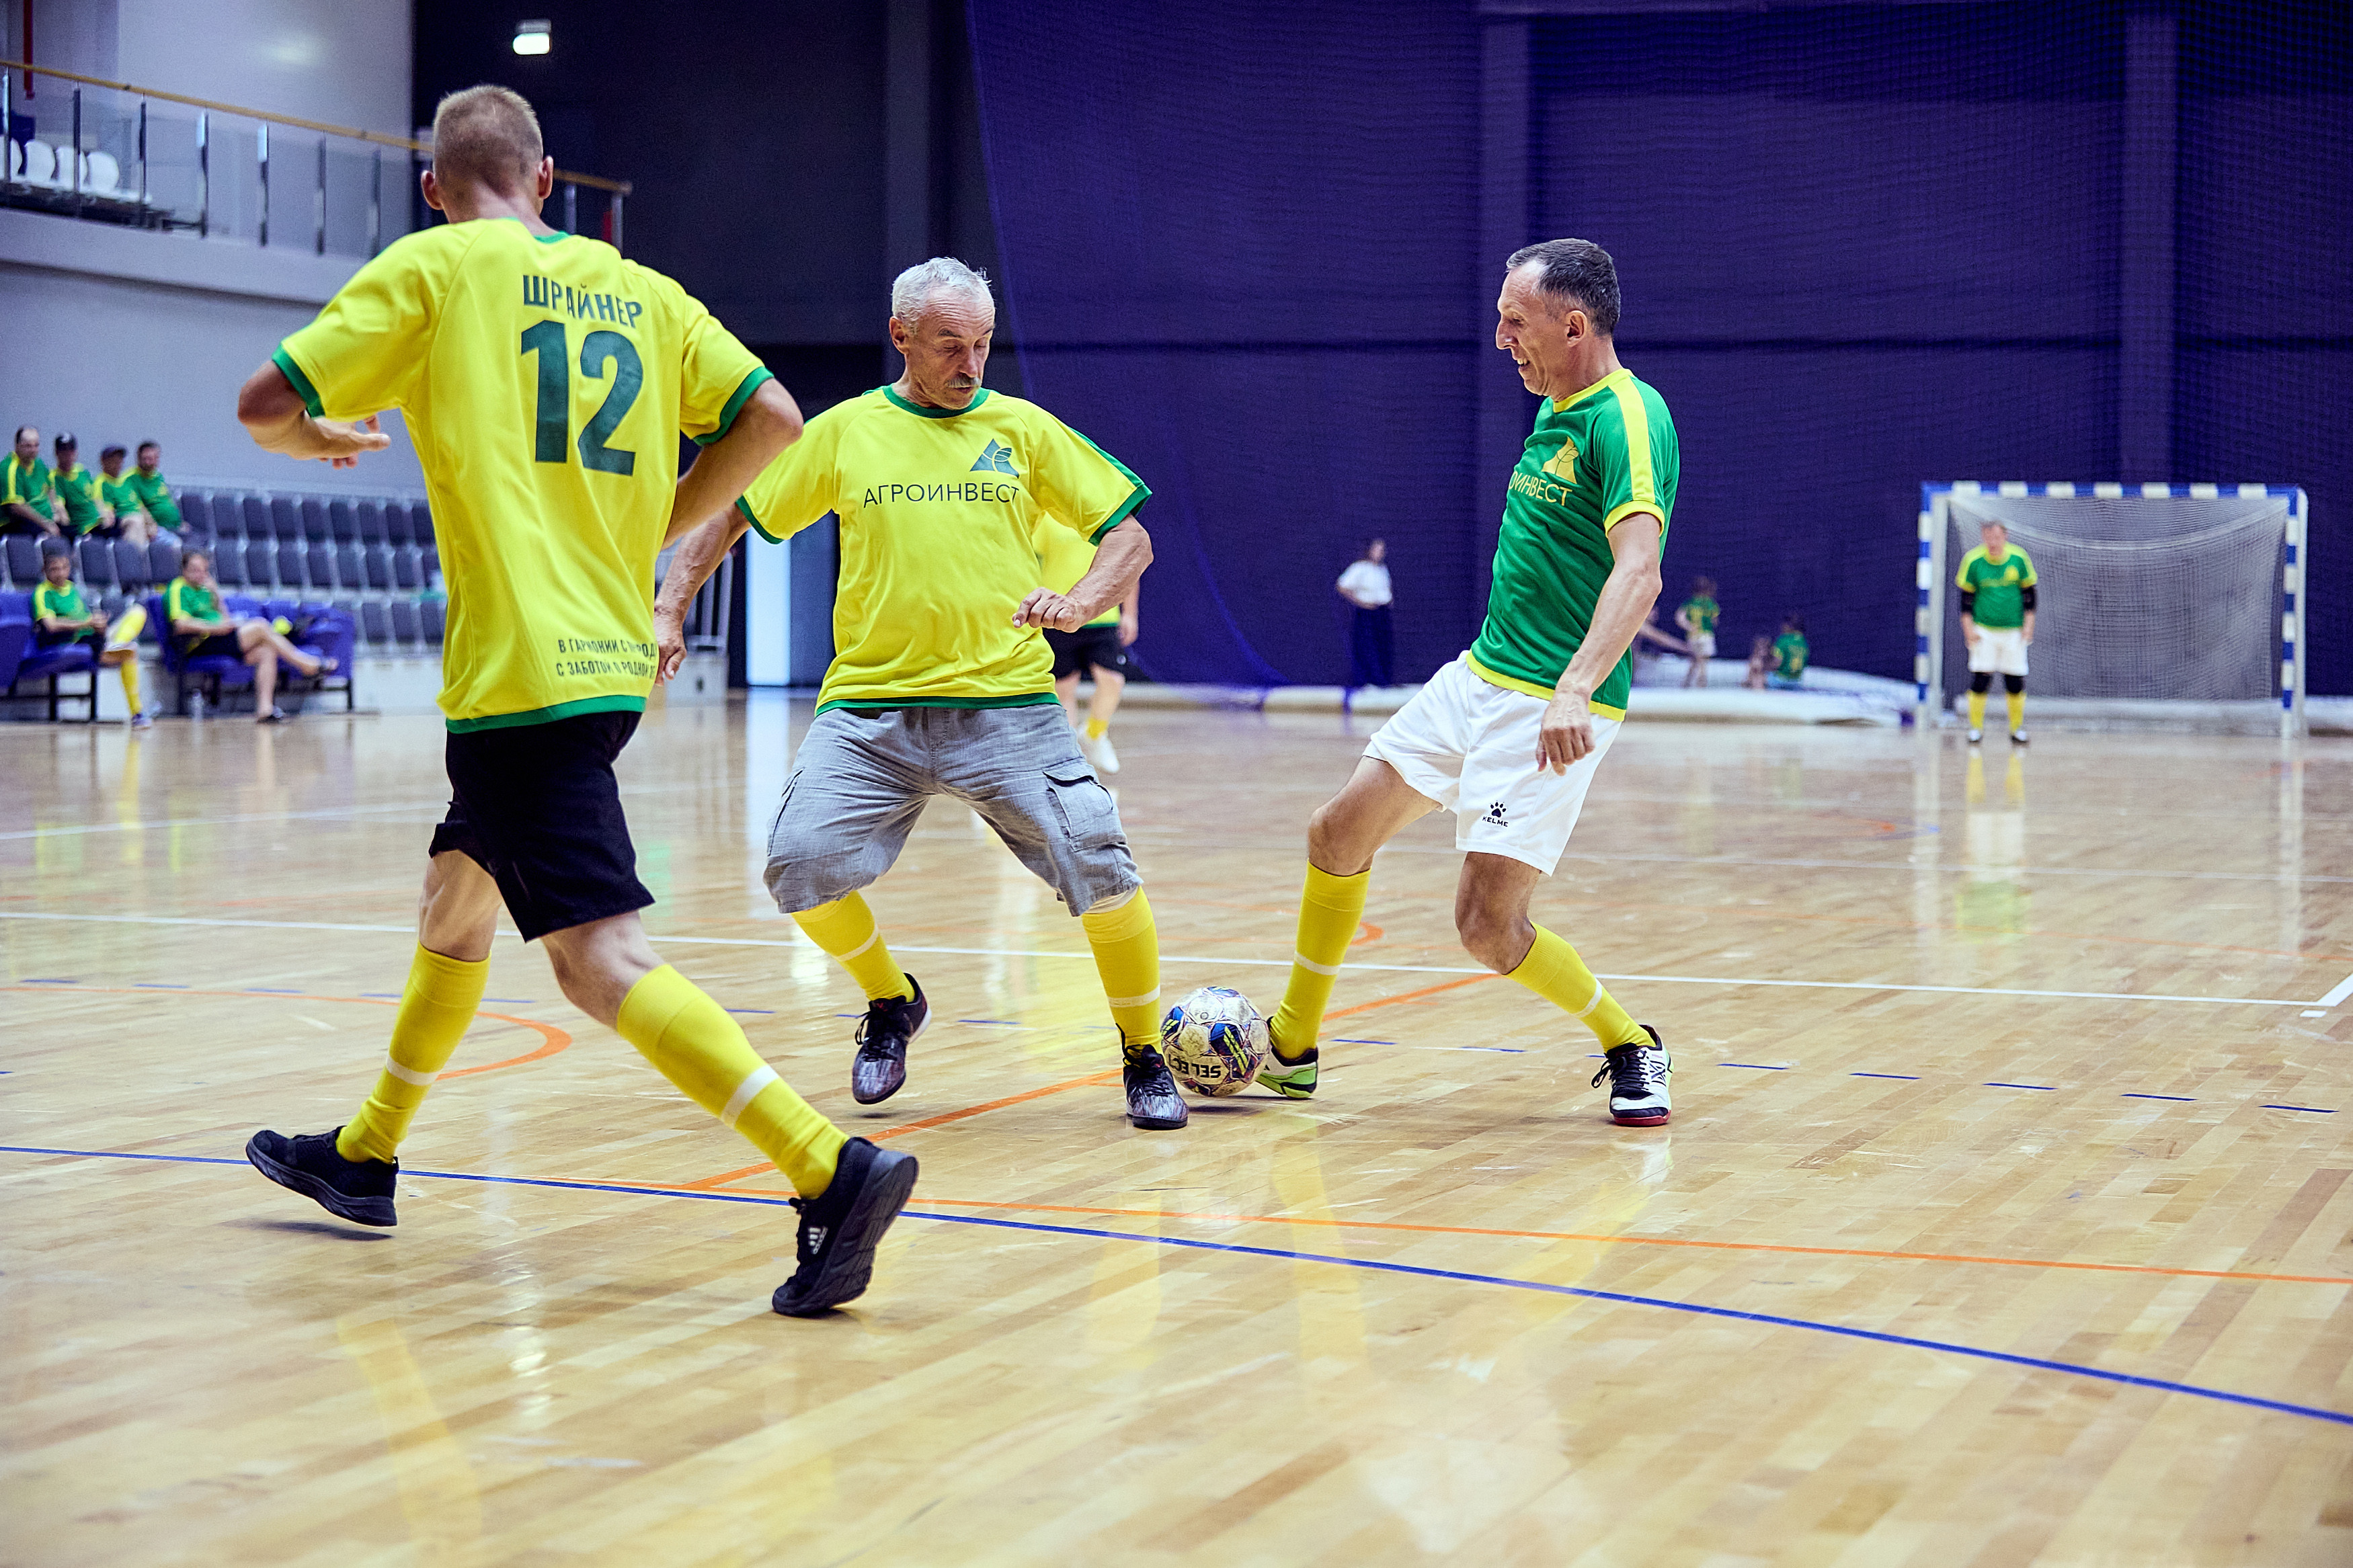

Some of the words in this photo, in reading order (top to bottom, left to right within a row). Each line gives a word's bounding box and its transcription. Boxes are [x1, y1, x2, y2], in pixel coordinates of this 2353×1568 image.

[523, 275, 643, 328] ШРАЙНЕР
[521, 319, 643, 477] 12
[863, 483, 1020, 508] АГРОИНВЕСТ
[558, 639, 566, 653] В
[556, 663, 564, 676] С
[1482, 816, 1509, 827] KELME
